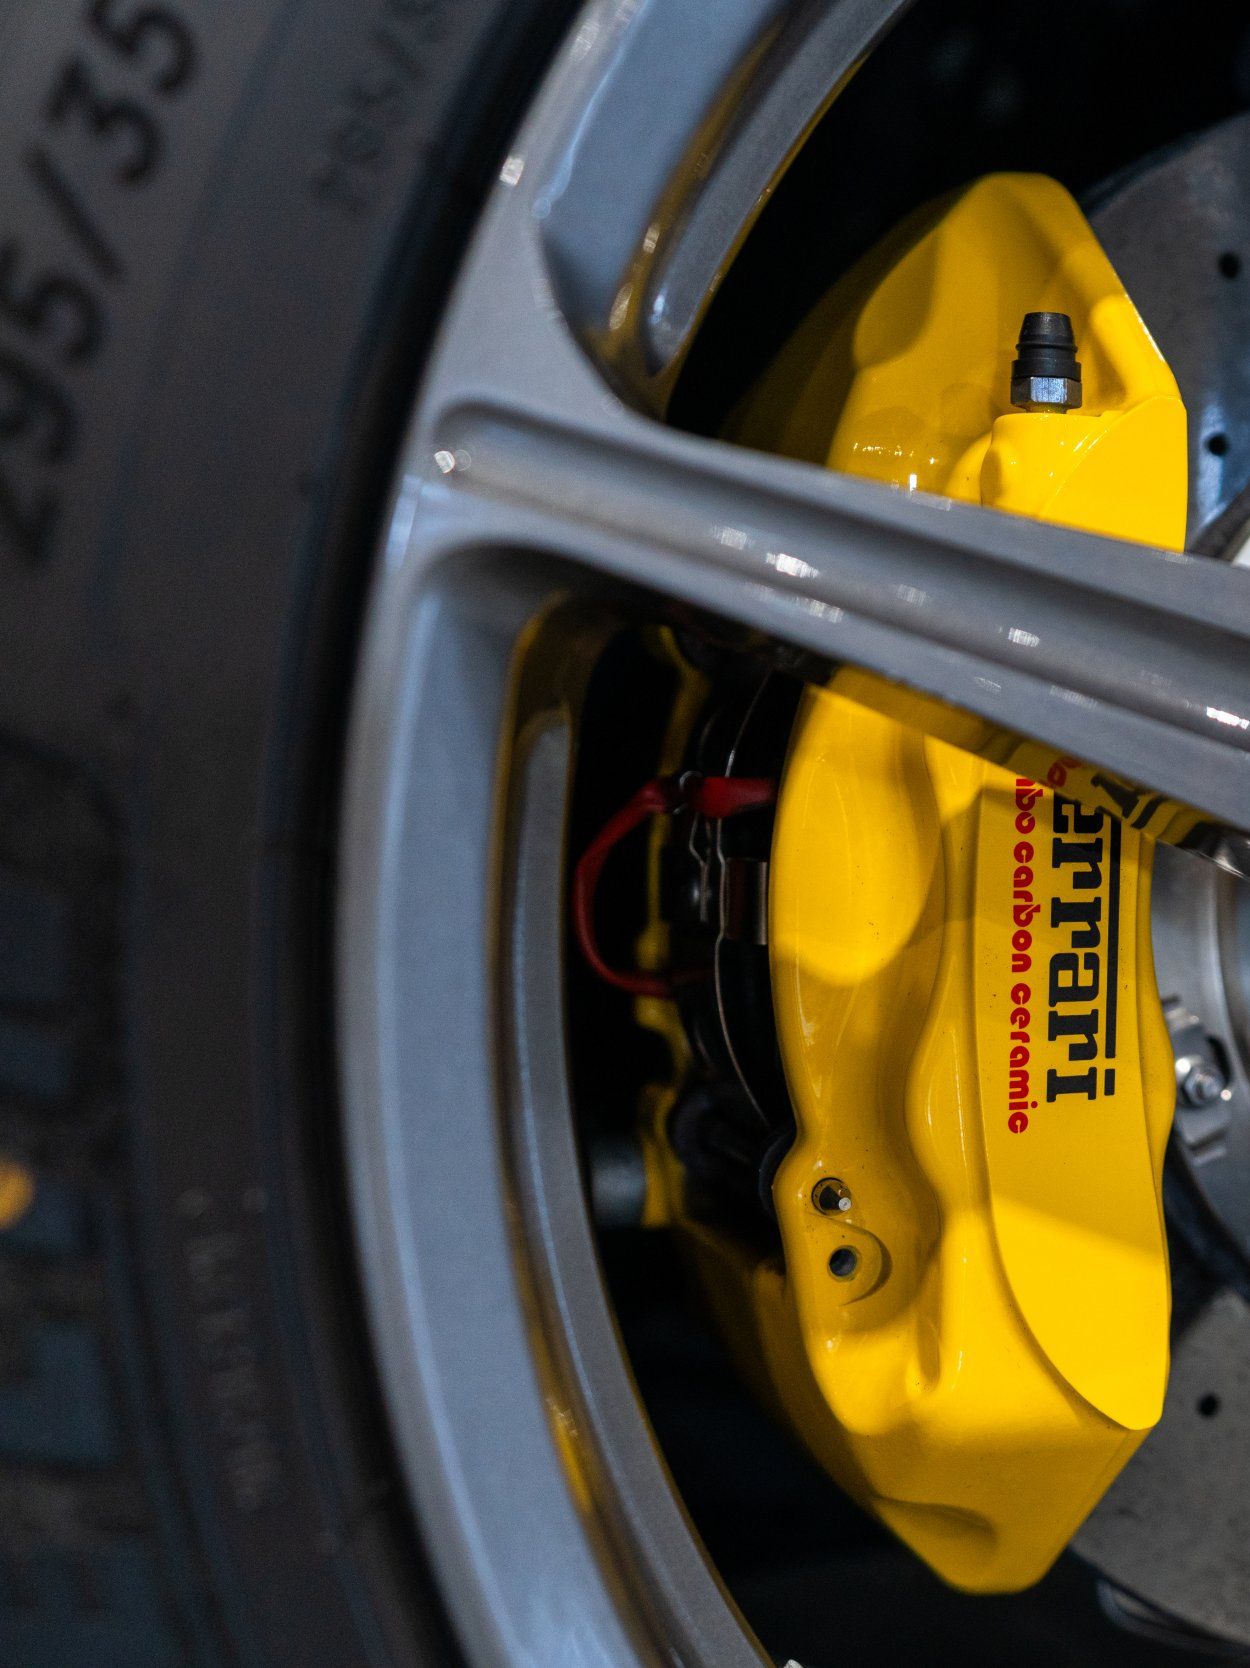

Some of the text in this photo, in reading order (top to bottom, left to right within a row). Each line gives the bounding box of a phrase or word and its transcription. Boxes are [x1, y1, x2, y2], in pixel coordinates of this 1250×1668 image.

[1011, 841, 1040, 973] carbon
[1046, 788, 1121, 1103] errari
[1008, 982, 1037, 1134] ceramic
